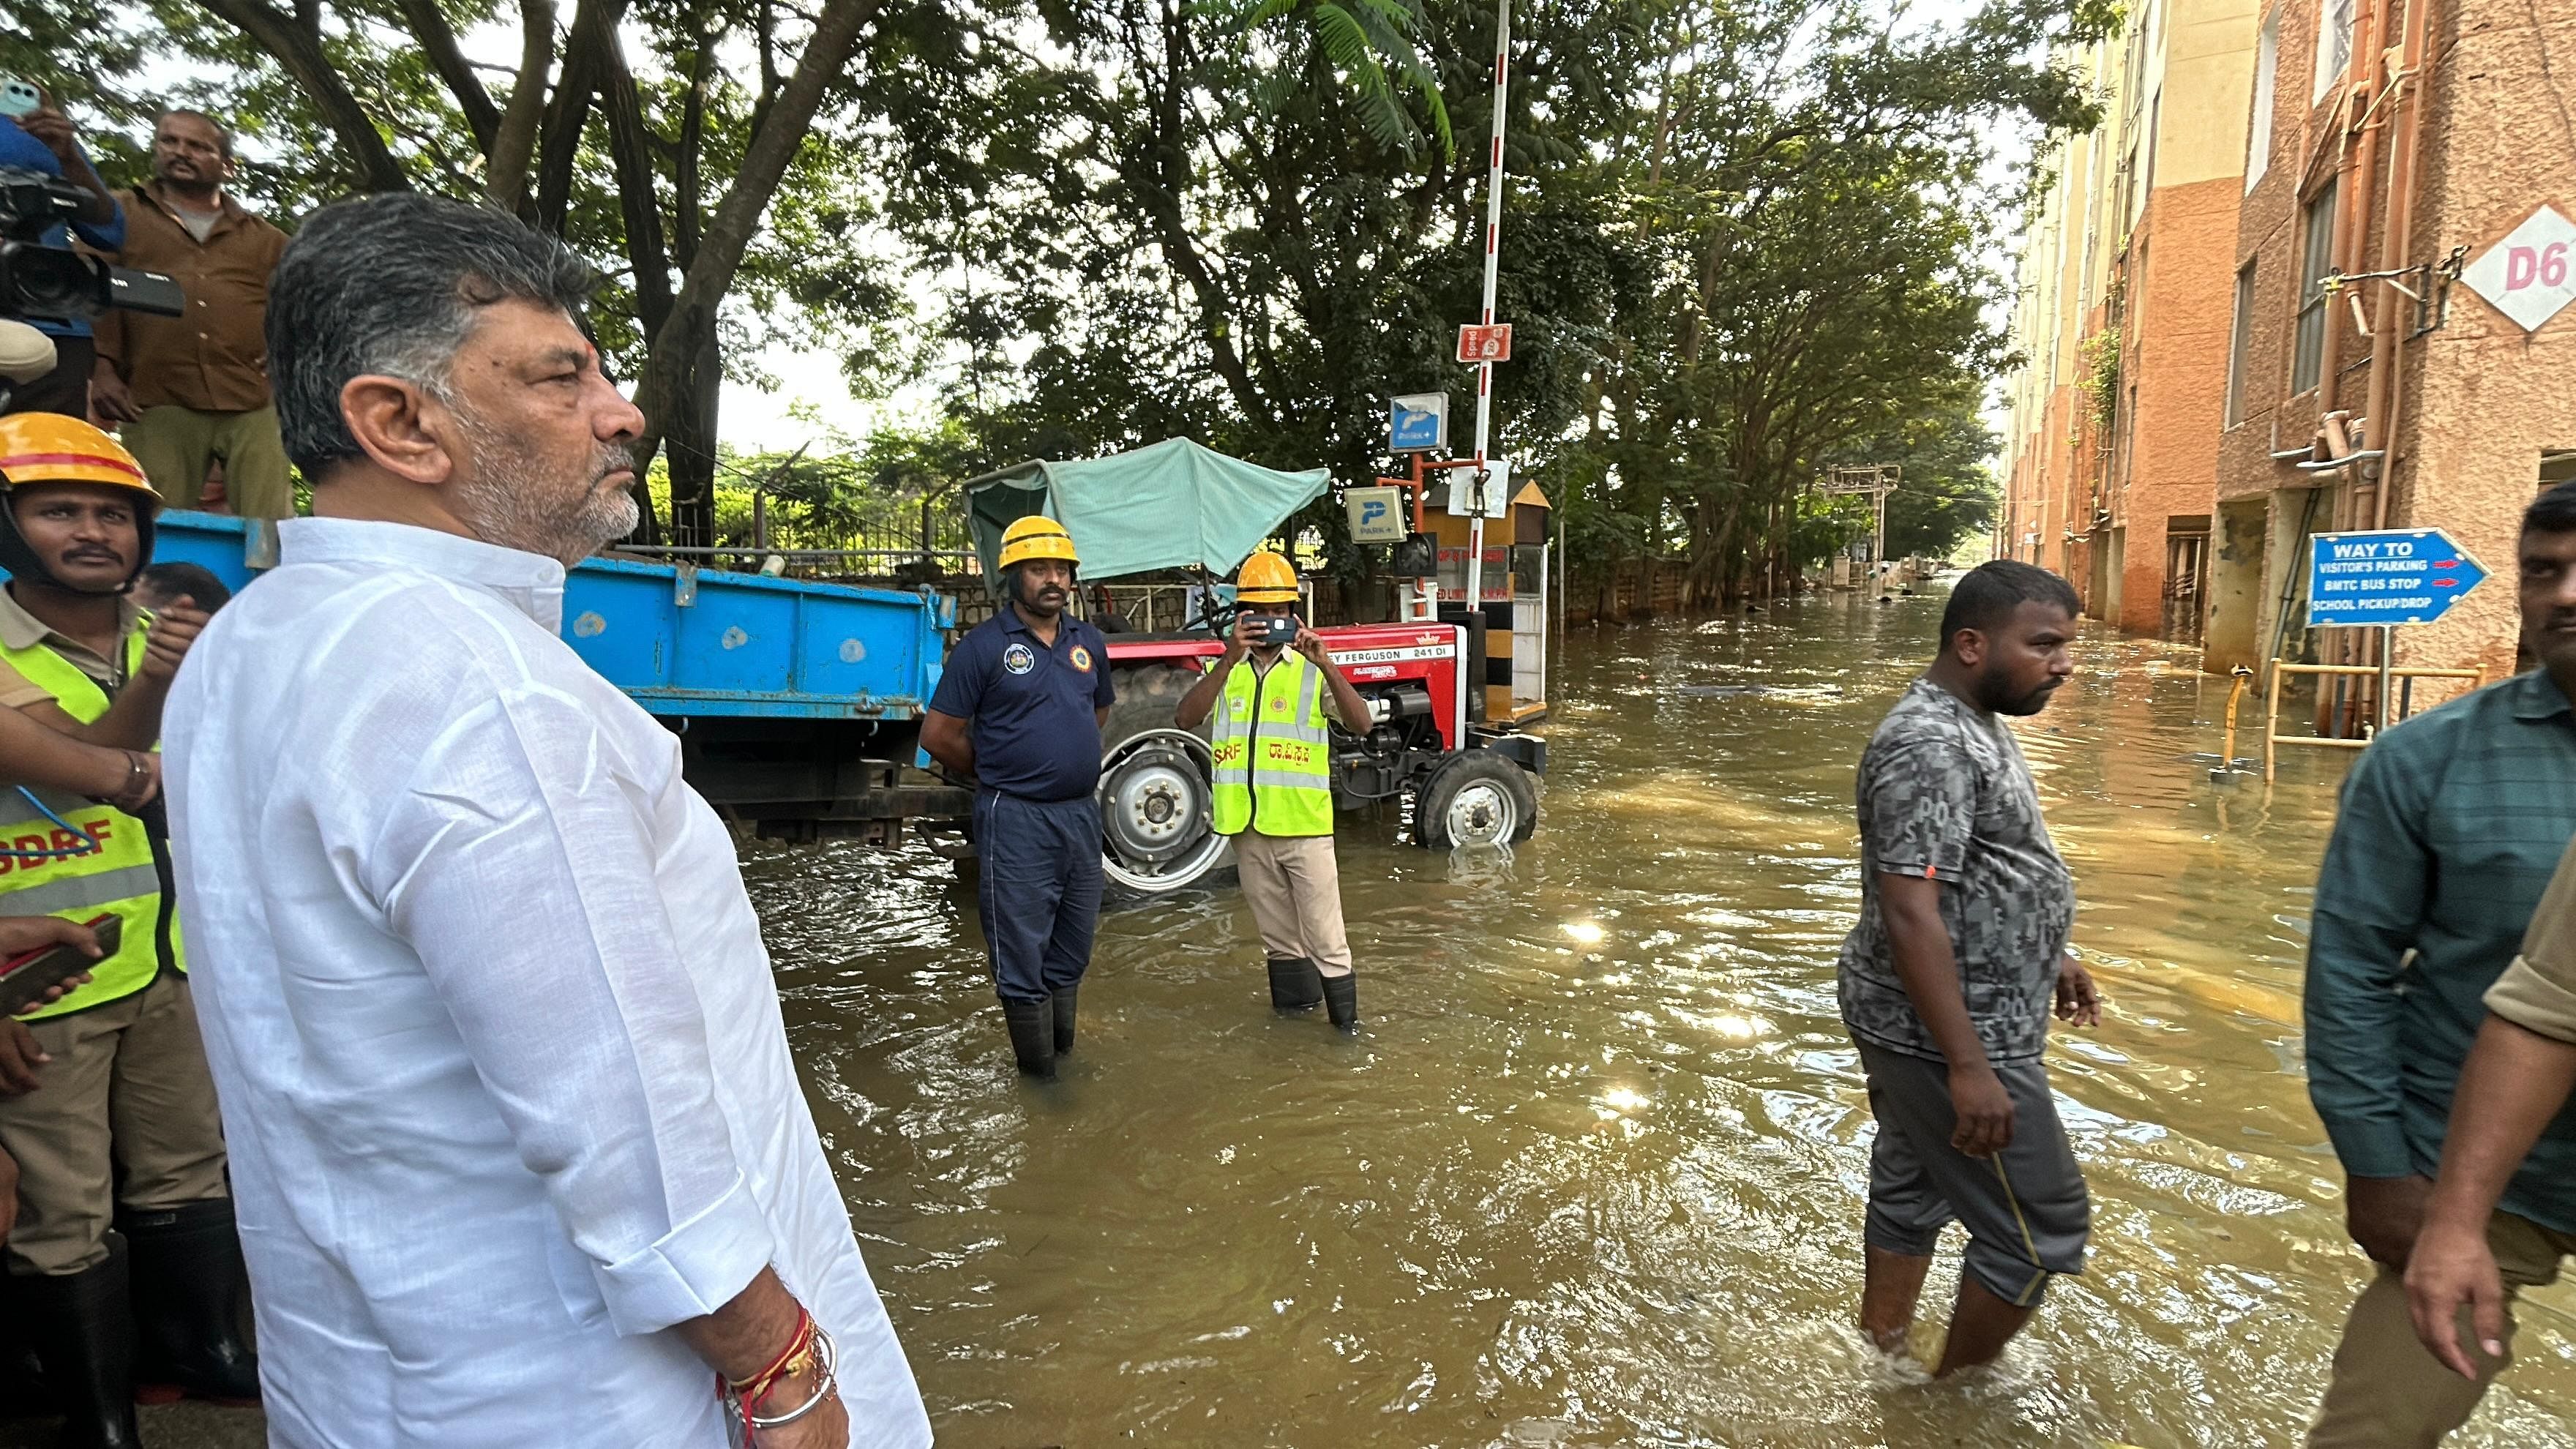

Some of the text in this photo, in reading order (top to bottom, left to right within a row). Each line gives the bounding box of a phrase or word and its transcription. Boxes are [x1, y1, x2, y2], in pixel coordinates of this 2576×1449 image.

[2505, 242, 2568, 291] D6
[1467, 332, 1478, 357] Speed
[2333, 543, 2412, 558] WAY TO
[2319, 560, 2427, 574] VISITOR'S PARKING
[2324, 578, 2421, 591] BMTC BUS STOP
[2313, 599, 2355, 611] SCHOOL
[1346, 651, 1401, 662] FERGUSON
[1414, 648, 1433, 657] 241
